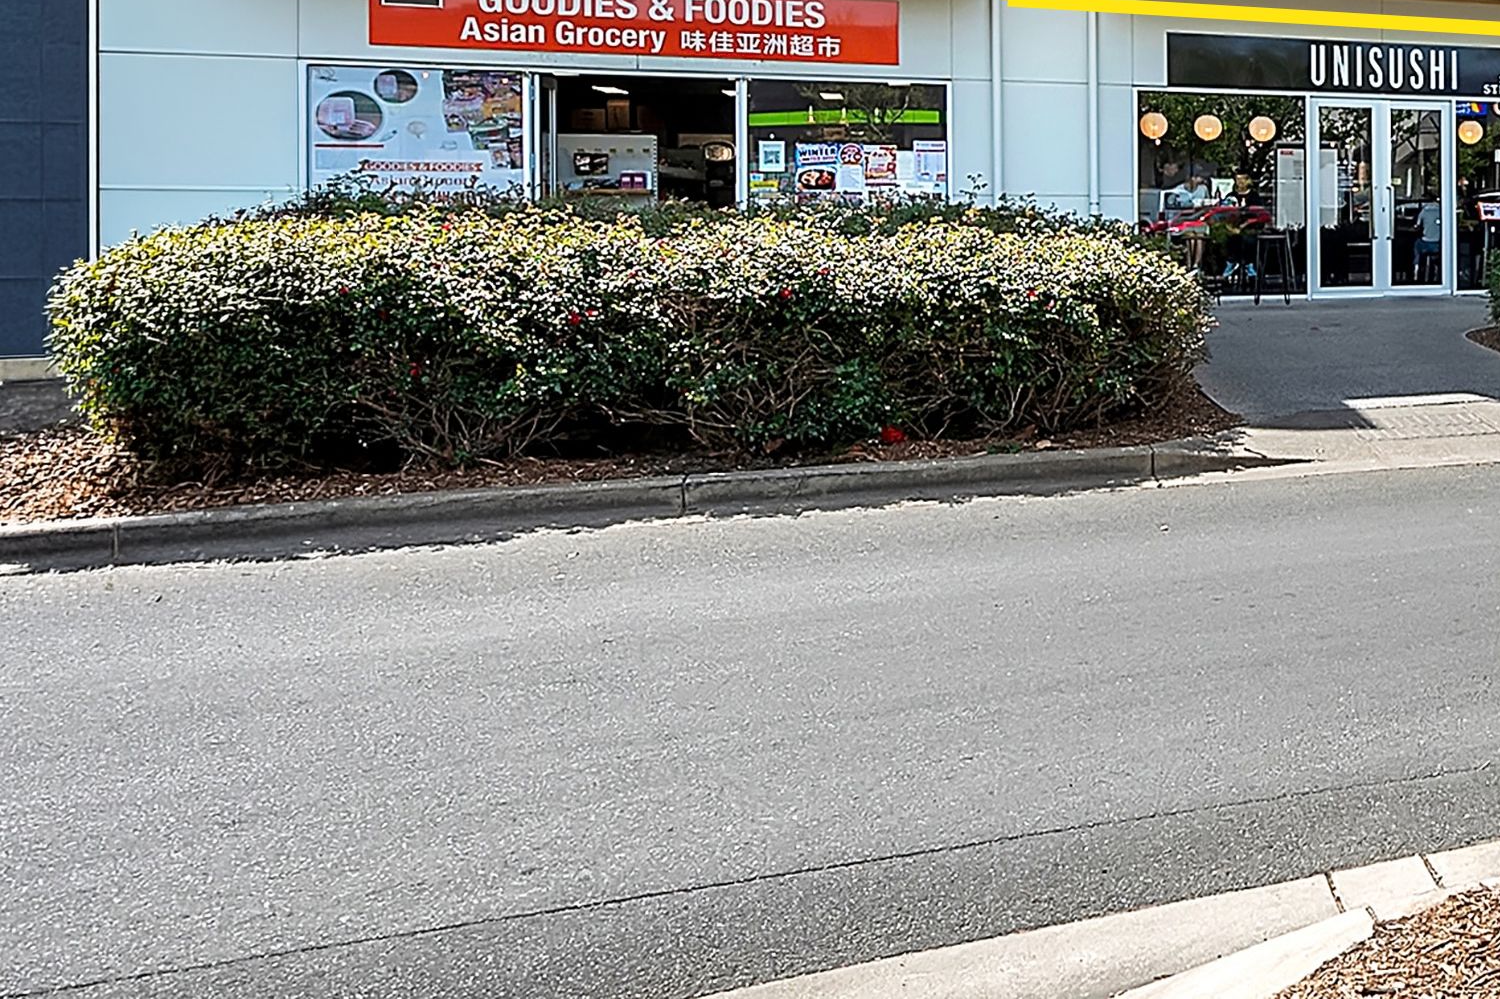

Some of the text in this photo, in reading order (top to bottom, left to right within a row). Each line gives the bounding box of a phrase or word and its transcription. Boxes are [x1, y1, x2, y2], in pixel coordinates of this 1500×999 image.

[460, 16, 666, 53] Asian Grocery
[680, 30, 841, 58] 味佳亚洲超市
[1310, 44, 1458, 90] UNISUSHI
